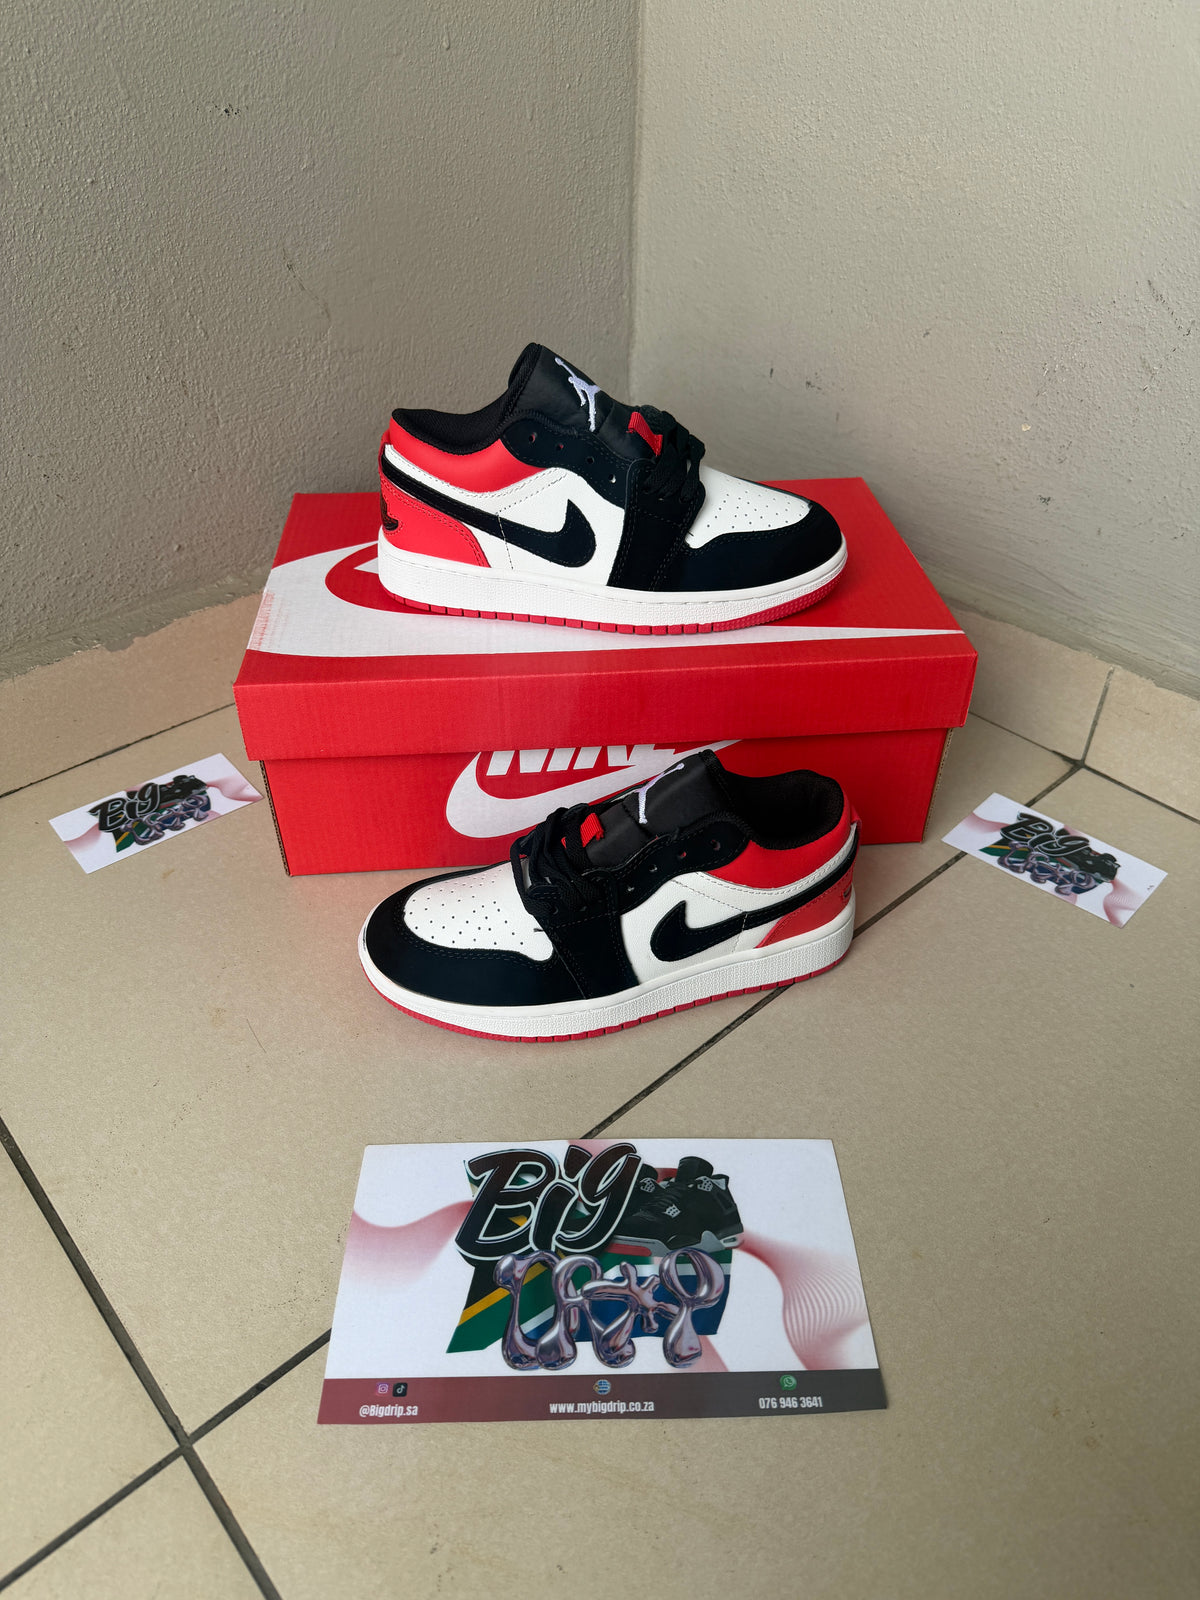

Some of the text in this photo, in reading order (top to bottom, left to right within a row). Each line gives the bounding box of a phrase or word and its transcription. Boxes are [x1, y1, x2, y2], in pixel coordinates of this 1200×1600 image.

[88, 782, 161, 832] Big
[1000, 812, 1090, 857] Big
[454, 1141, 642, 1261] Big
[359, 1404, 419, 1418] @Bigdrip.sa
[549, 1400, 655, 1415] www.mybigdrip.co.za
[758, 1395, 823, 1409] 076 946 3641
